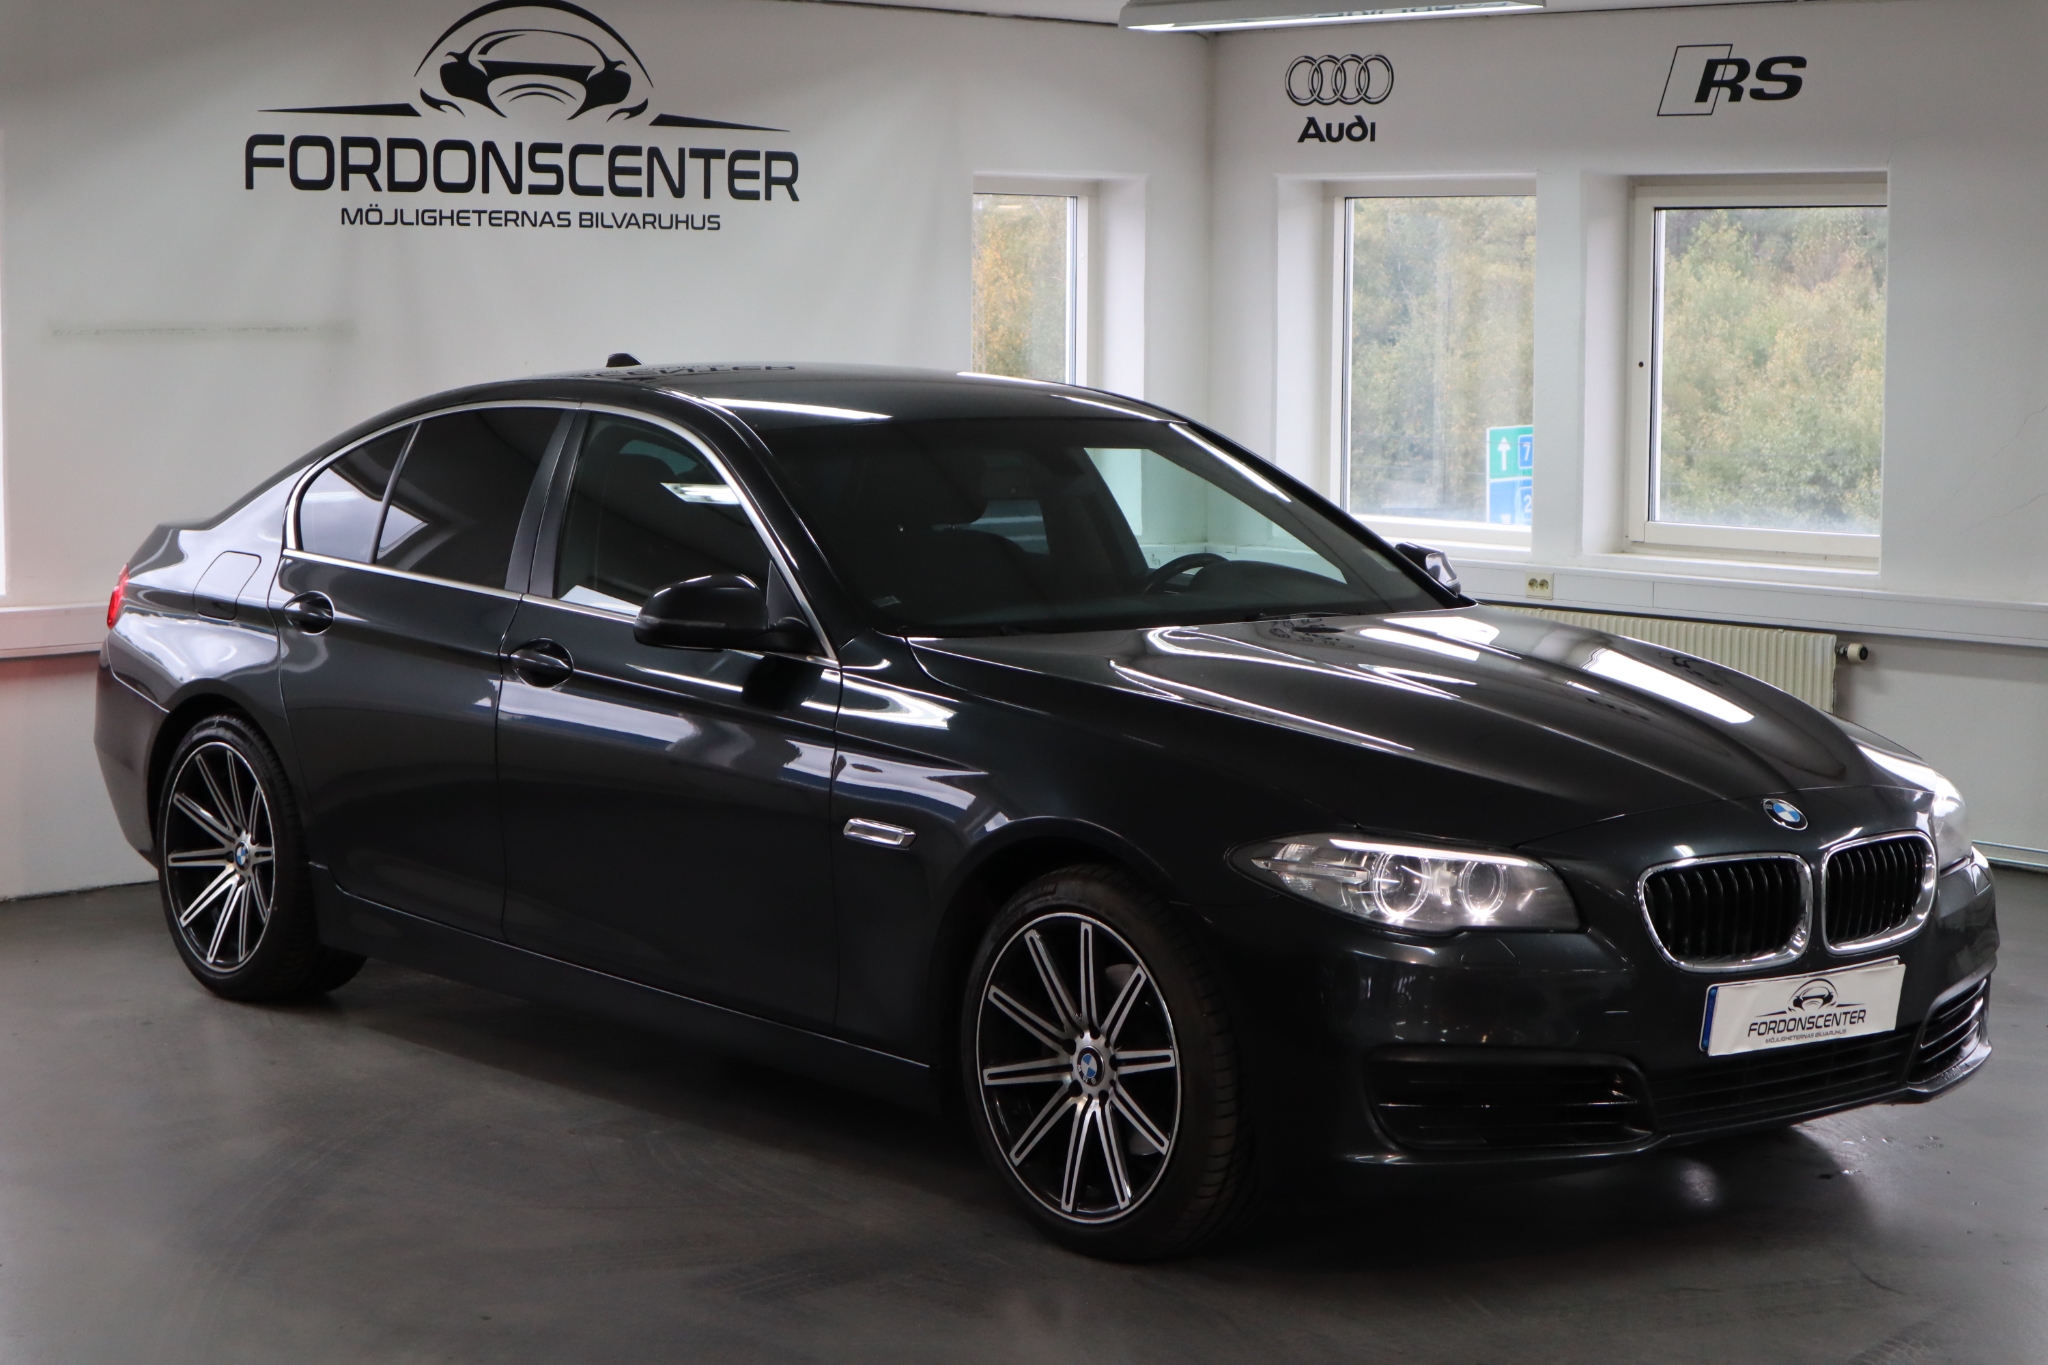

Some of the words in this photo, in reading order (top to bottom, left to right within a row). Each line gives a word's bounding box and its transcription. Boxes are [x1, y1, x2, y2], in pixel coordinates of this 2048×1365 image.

[1694, 56, 1808, 103] RS
[1297, 115, 1376, 143] Audi
[244, 133, 800, 202] FORDONSCENTER
[340, 204, 572, 228] MÖJLIGHETERNAS
[578, 211, 721, 231] BILVARUHUS
[1747, 1009, 1867, 1037] FORDONSCENTER
